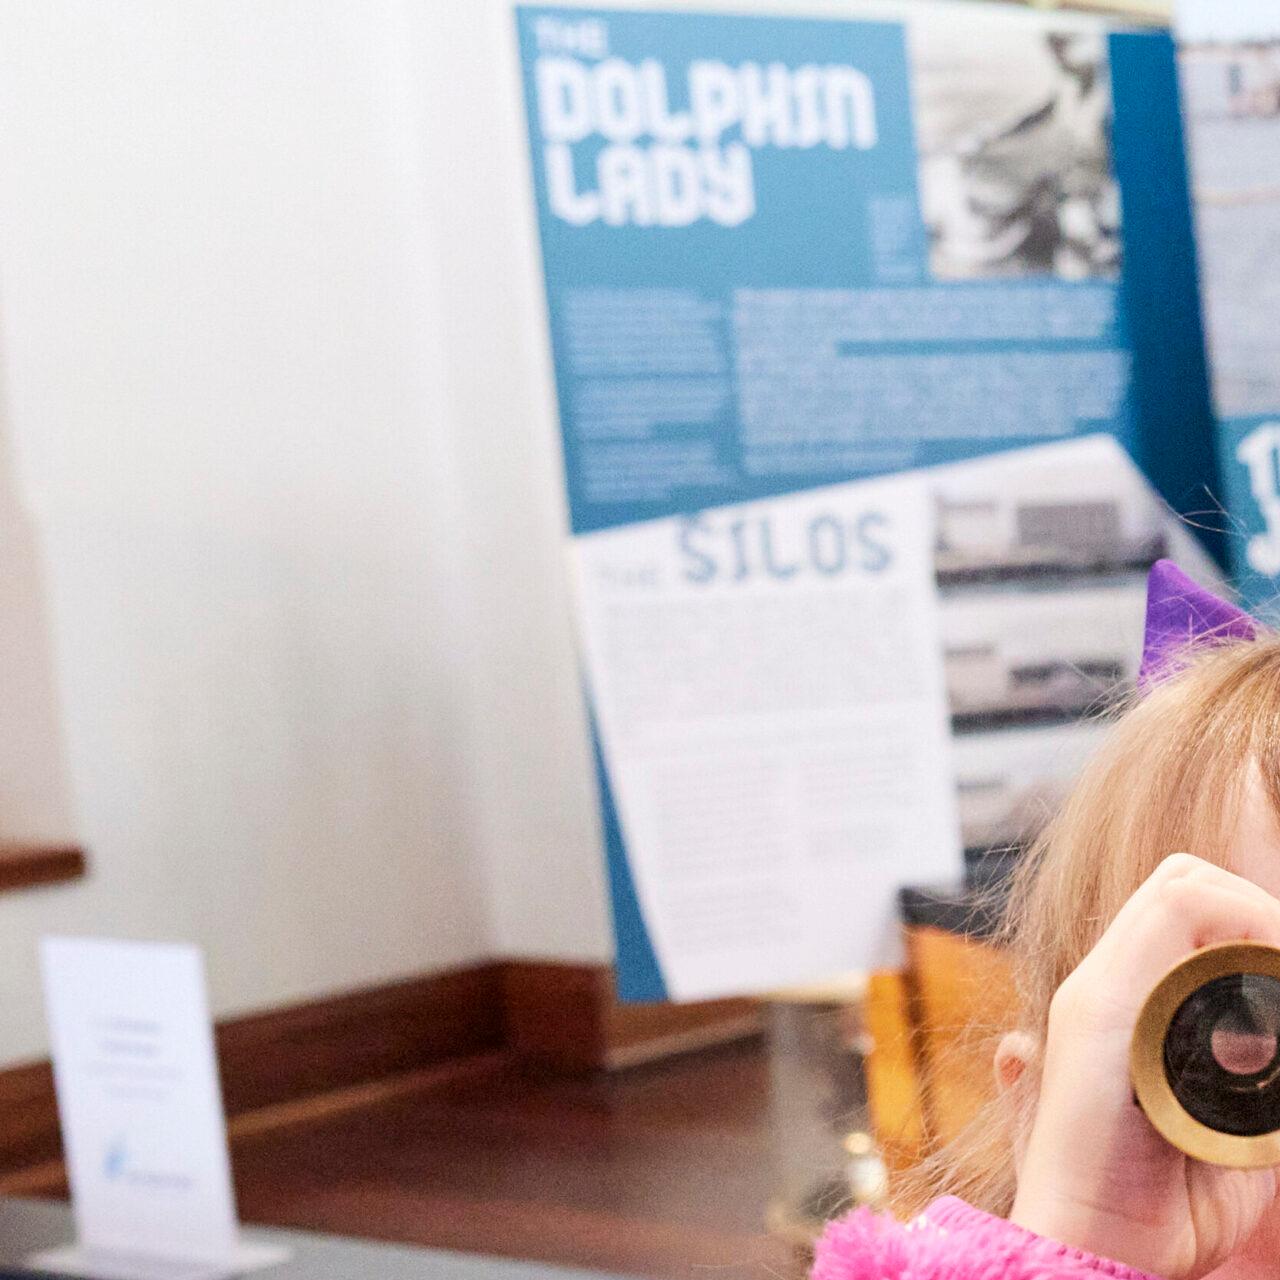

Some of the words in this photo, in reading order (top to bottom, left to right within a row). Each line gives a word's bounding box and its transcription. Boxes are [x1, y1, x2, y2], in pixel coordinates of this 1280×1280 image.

[536, 58, 876, 149] DOLPHIN
[546, 144, 754, 226] LADY
[679, 507, 895, 585] SILOS
